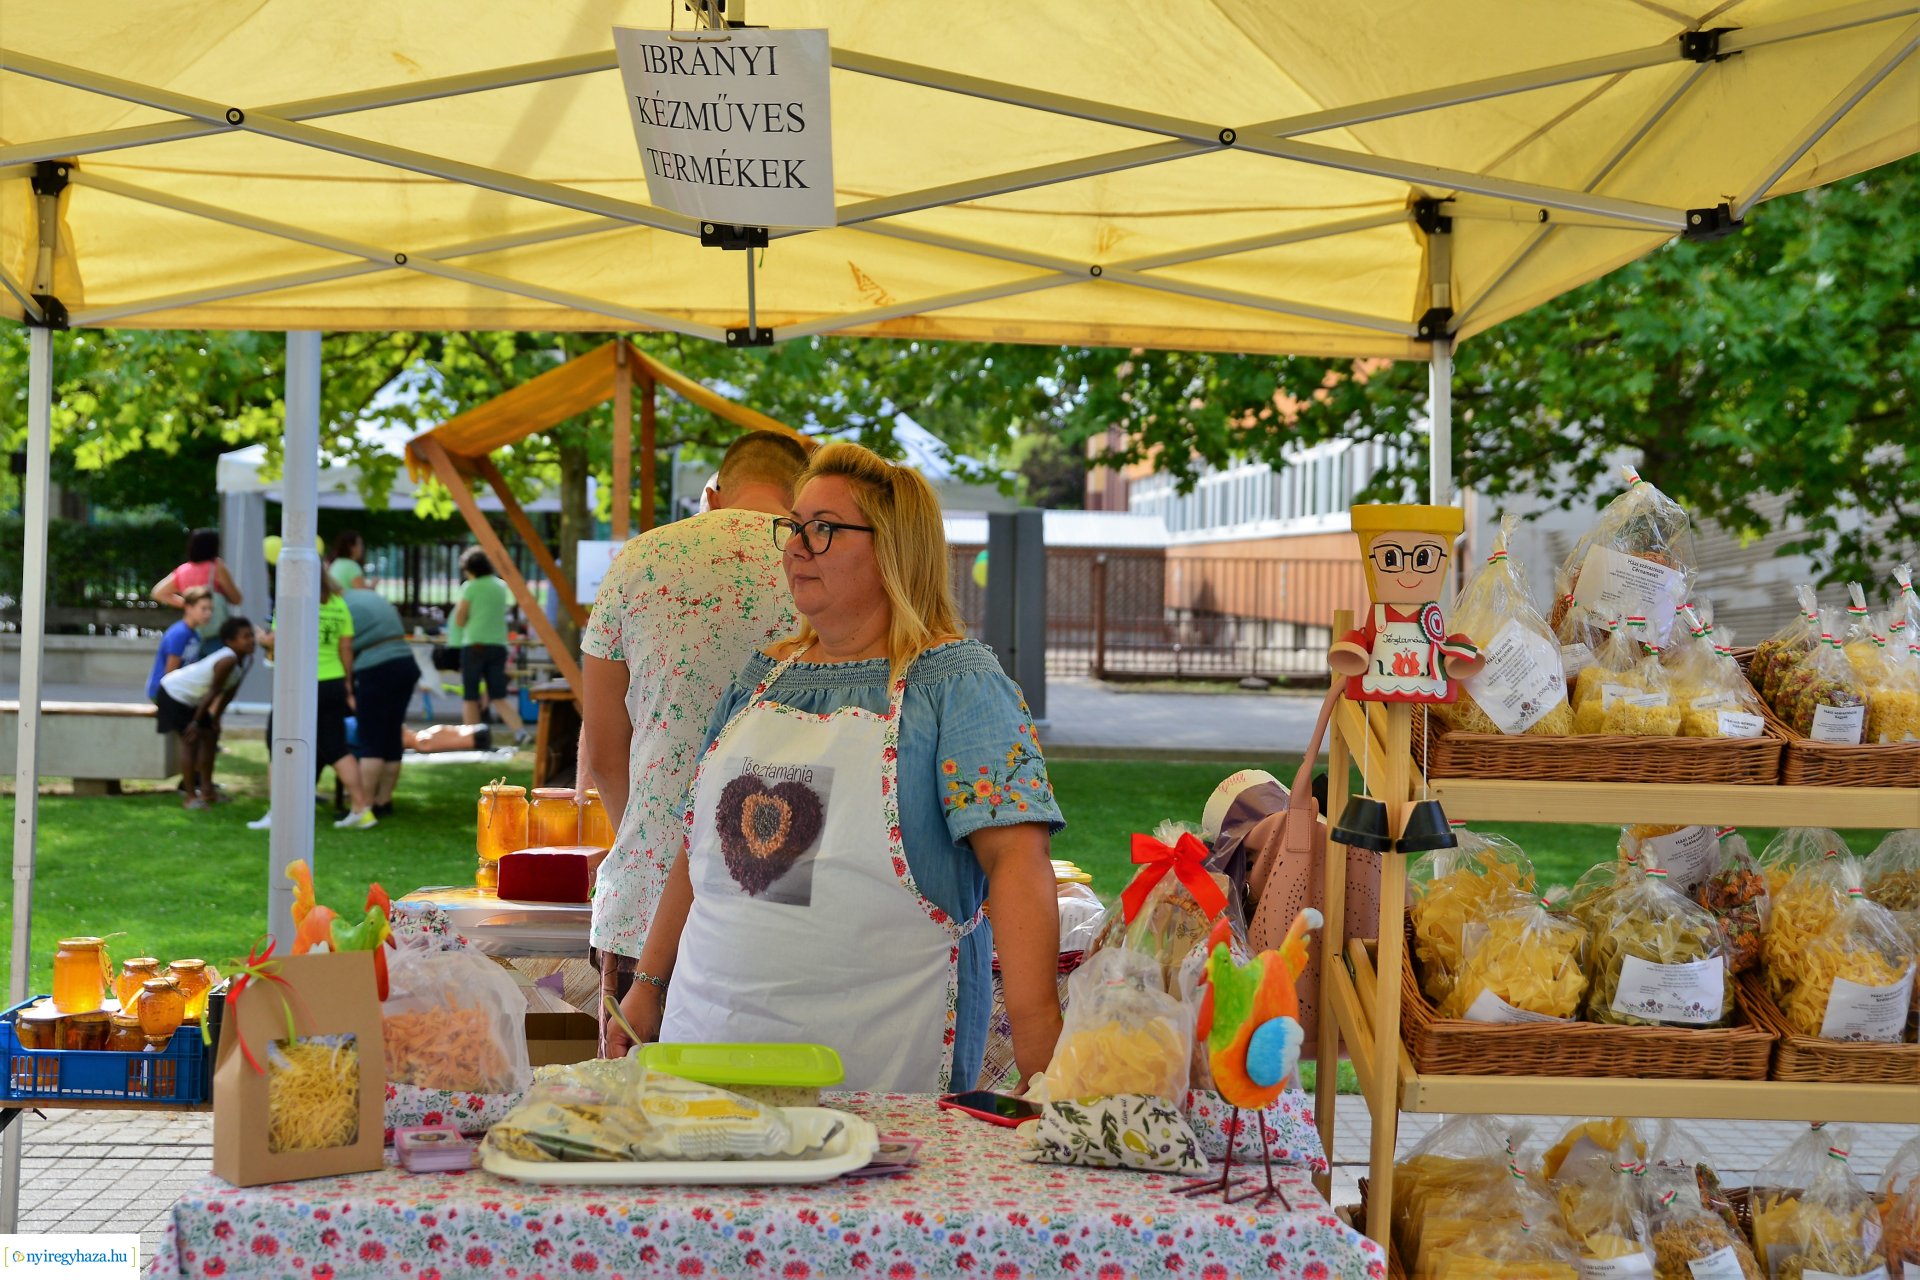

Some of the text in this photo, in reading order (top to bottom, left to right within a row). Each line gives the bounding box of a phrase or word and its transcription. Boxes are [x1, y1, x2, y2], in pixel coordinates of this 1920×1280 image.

[635, 90, 805, 133] KÉZMŰVES
[647, 148, 810, 189] TERMÉKEK
[741, 757, 814, 783] Tésztamánia
